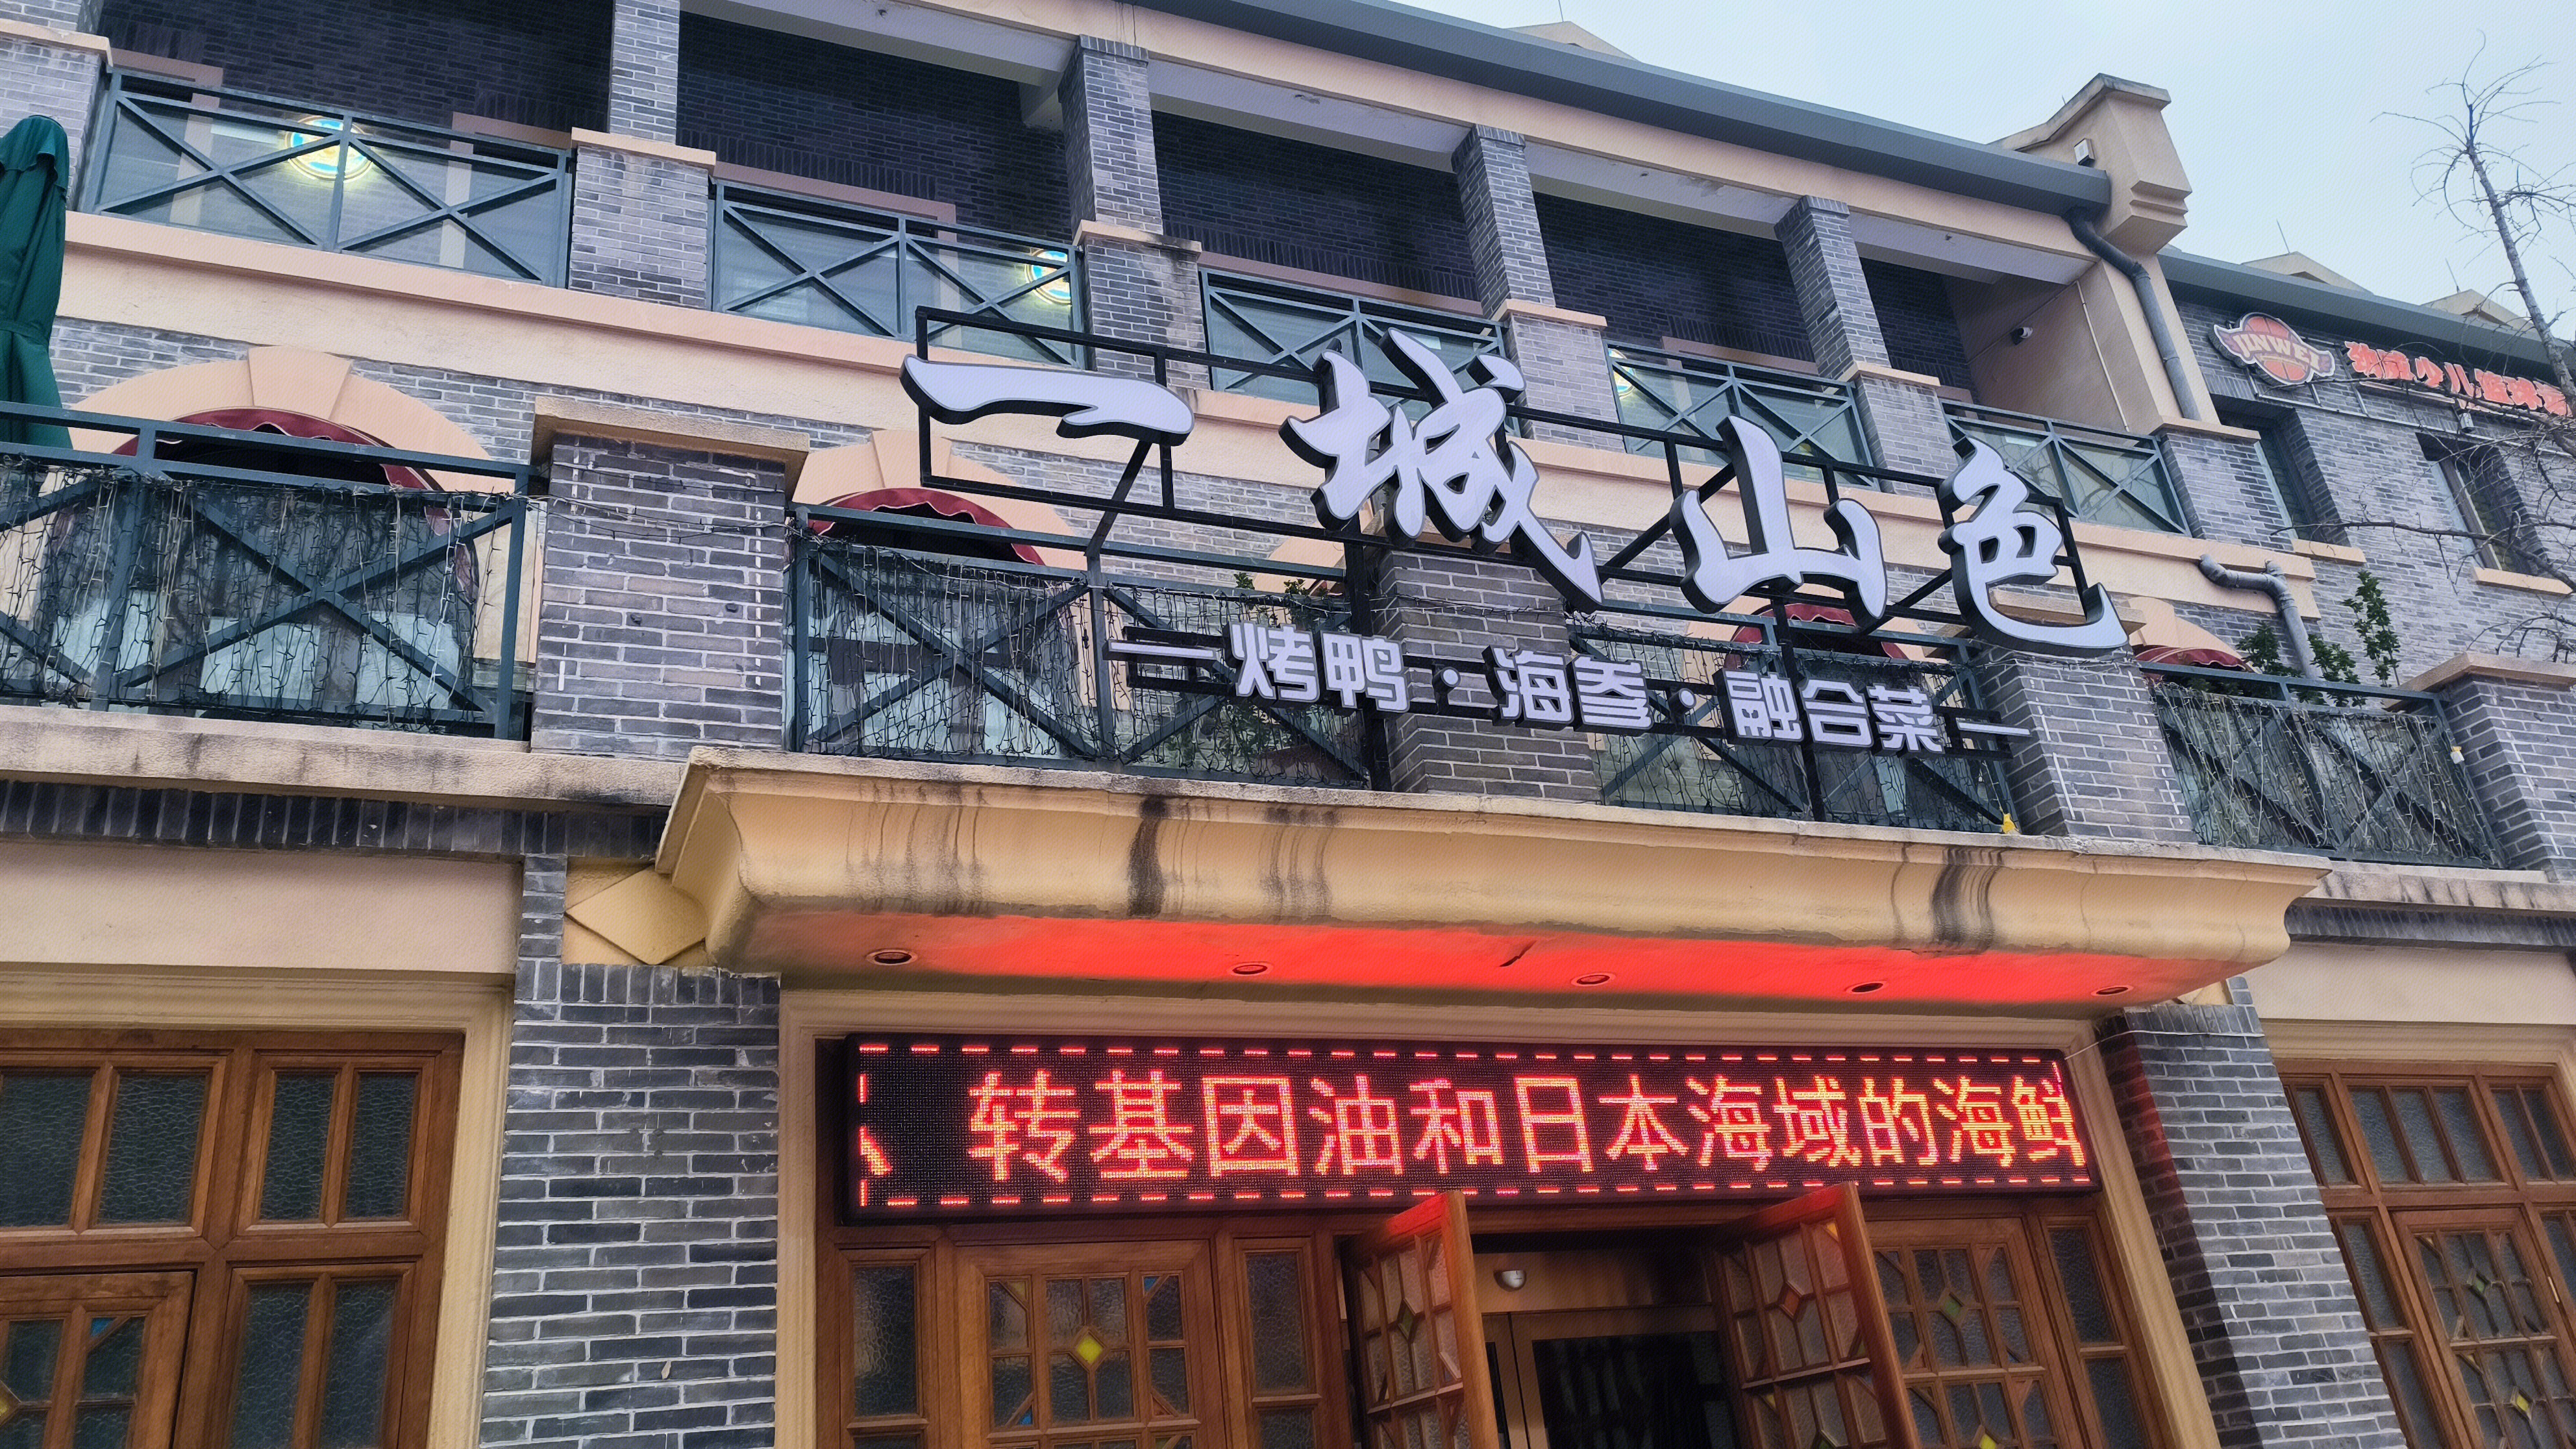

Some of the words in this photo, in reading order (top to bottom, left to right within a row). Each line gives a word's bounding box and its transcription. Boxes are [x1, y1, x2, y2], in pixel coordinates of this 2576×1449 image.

[2232, 333, 2321, 371] JINWEI
[900, 328, 2129, 650] 一城山色
